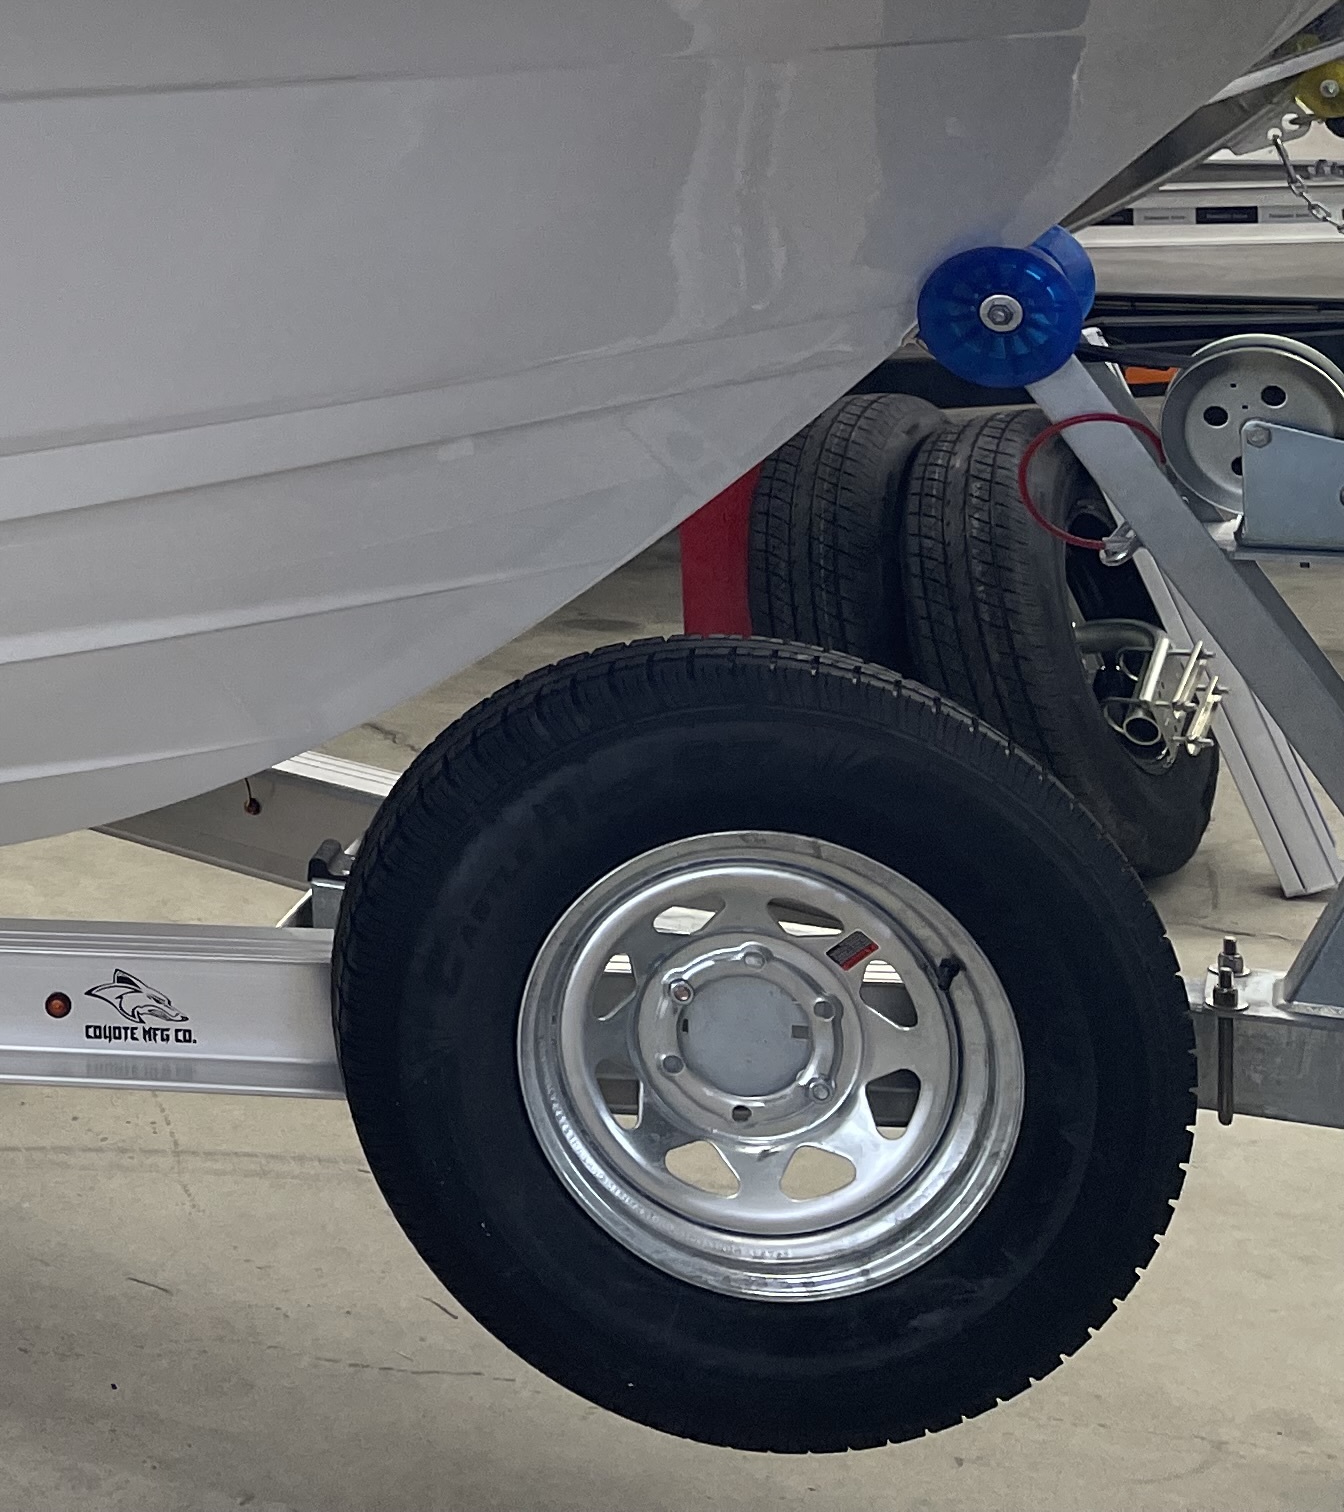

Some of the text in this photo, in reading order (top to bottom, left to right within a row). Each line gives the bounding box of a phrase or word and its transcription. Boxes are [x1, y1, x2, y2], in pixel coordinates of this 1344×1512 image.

[85, 1025, 197, 1043] COYOTE MFG CO.
